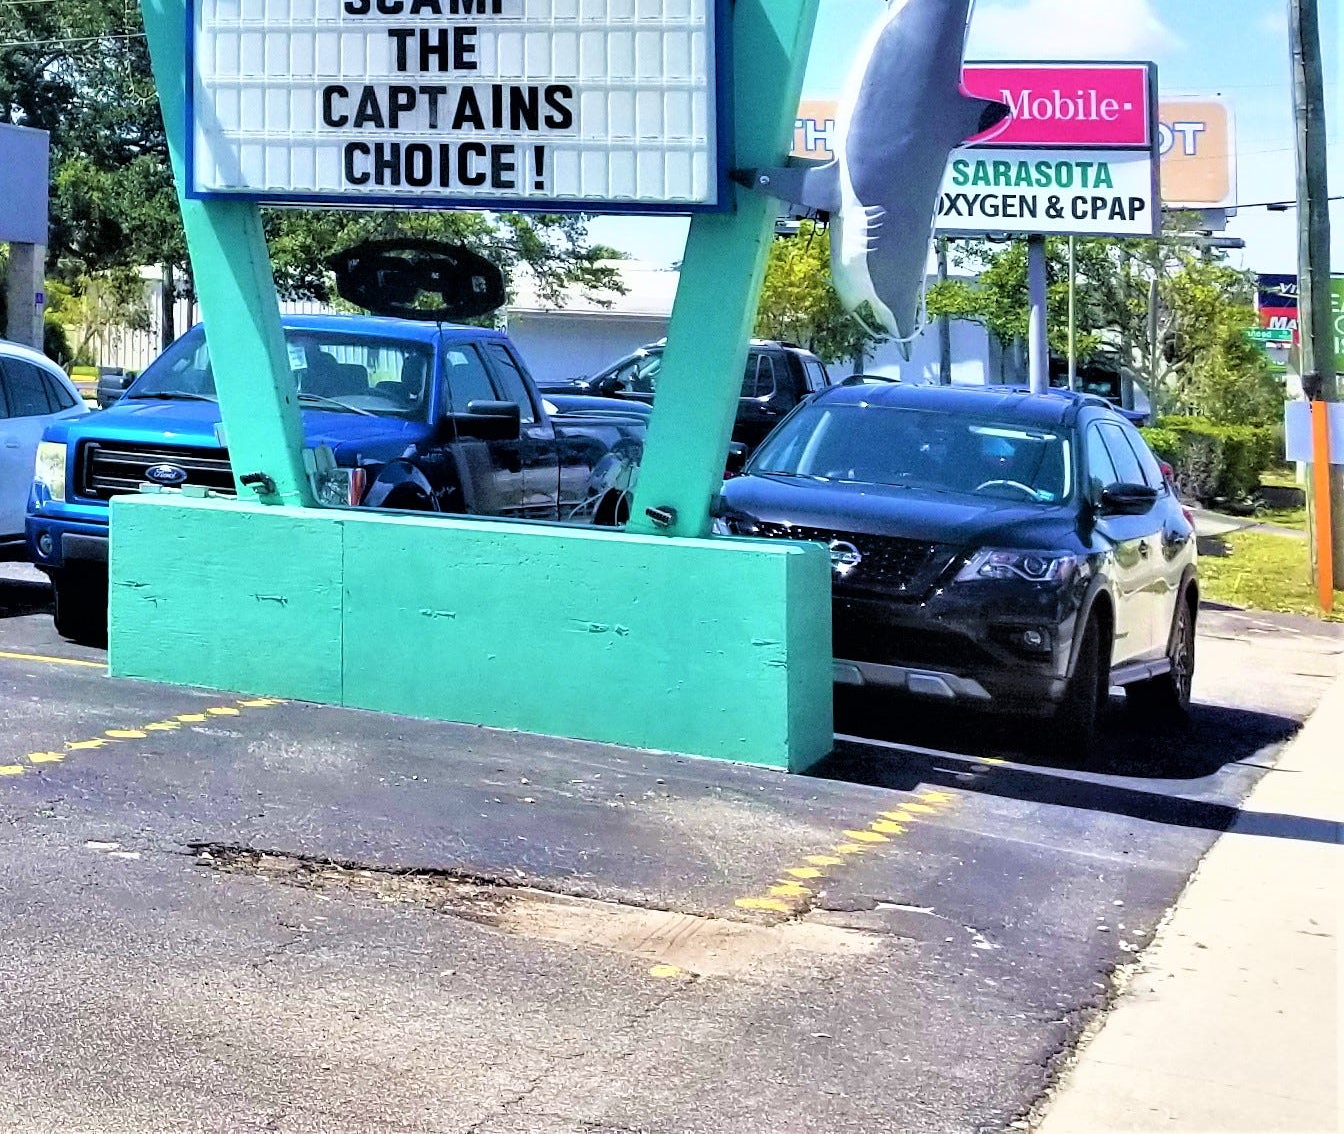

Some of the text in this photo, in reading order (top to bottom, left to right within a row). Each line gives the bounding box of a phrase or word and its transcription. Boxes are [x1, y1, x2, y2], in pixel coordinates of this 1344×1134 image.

[388, 26, 478, 72] THE
[322, 83, 574, 131] CAPTAINS
[343, 141, 516, 189] CHOICE
[952, 159, 1114, 189] SARASOTA
[938, 192, 1145, 221] XYGEN & CPAP
